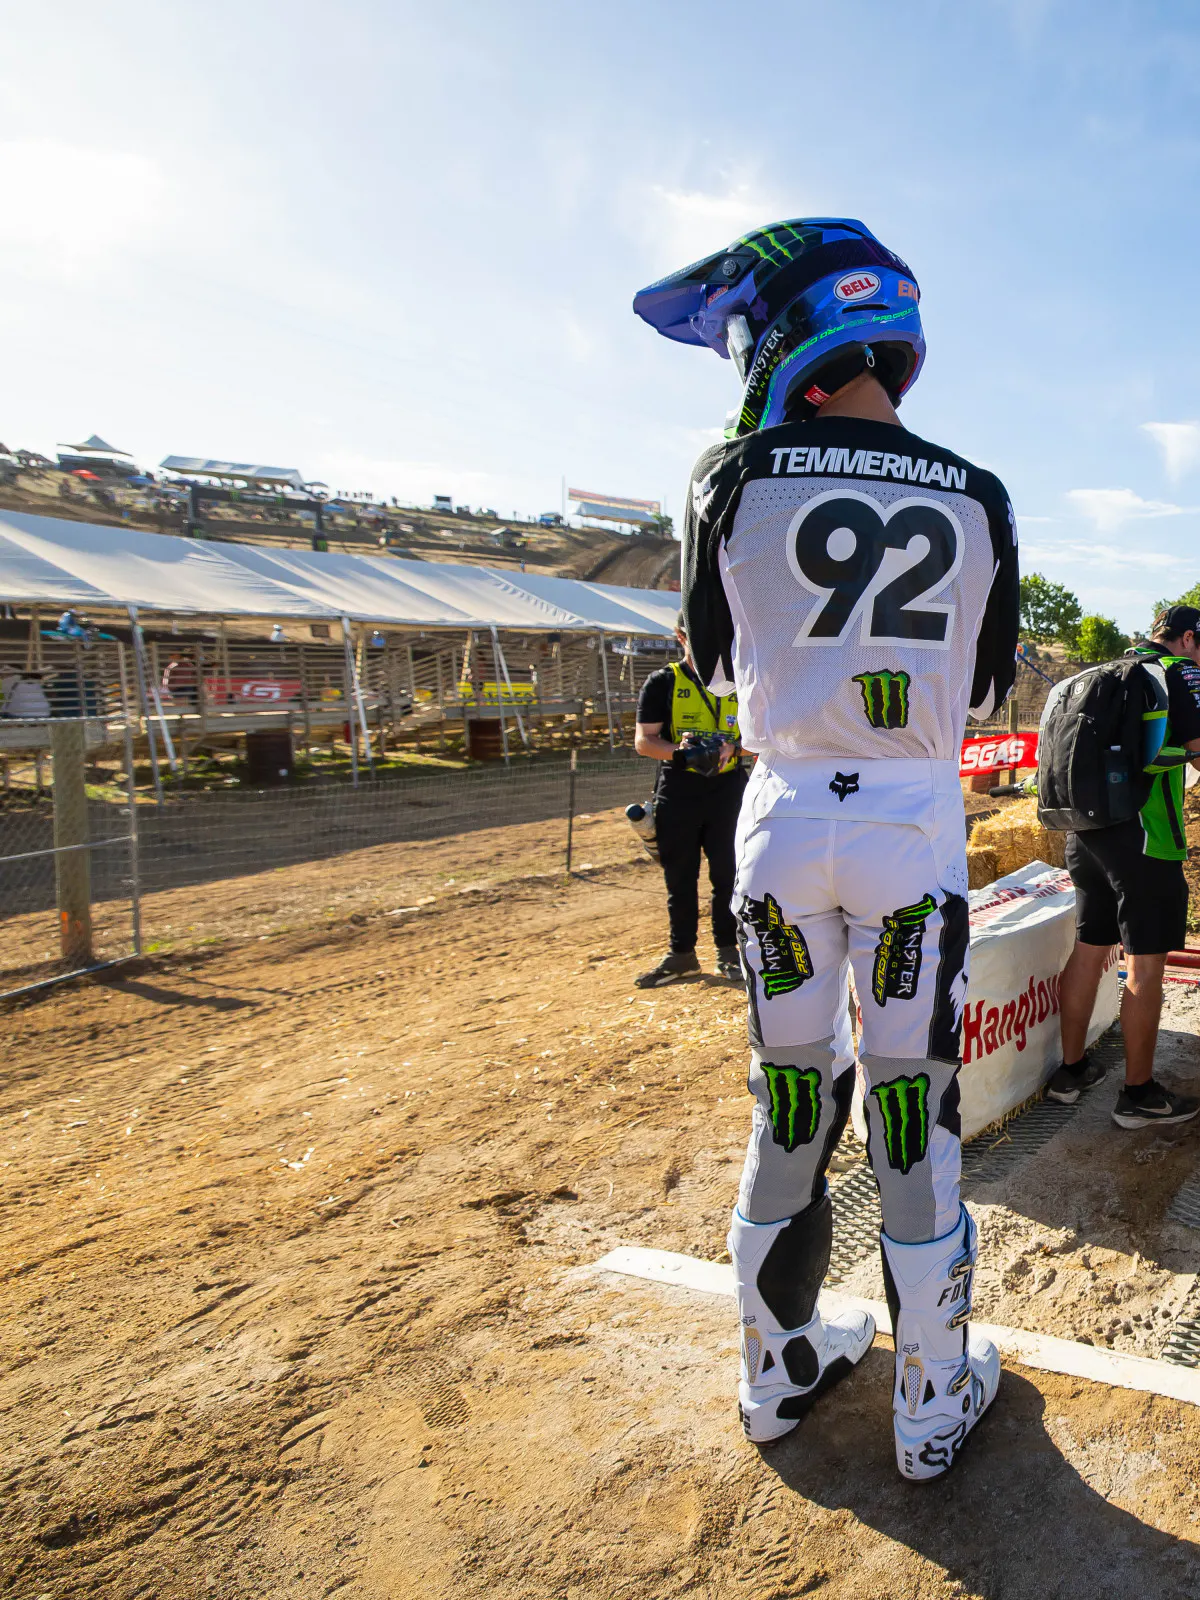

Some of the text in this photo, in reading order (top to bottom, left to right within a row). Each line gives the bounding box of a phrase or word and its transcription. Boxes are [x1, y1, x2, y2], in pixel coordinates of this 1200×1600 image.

[841, 277, 875, 297] BELL
[779, 323, 845, 372] PRO CIRCUIT
[770, 446, 968, 491] TEMMERMAN
[788, 490, 963, 648] 92
[677, 688, 690, 698] 20
[959, 740, 1025, 770] SGAS
[791, 941, 809, 974] PRO
[744, 1412, 752, 1436] FOX
[904, 1450, 914, 1475] FOX
